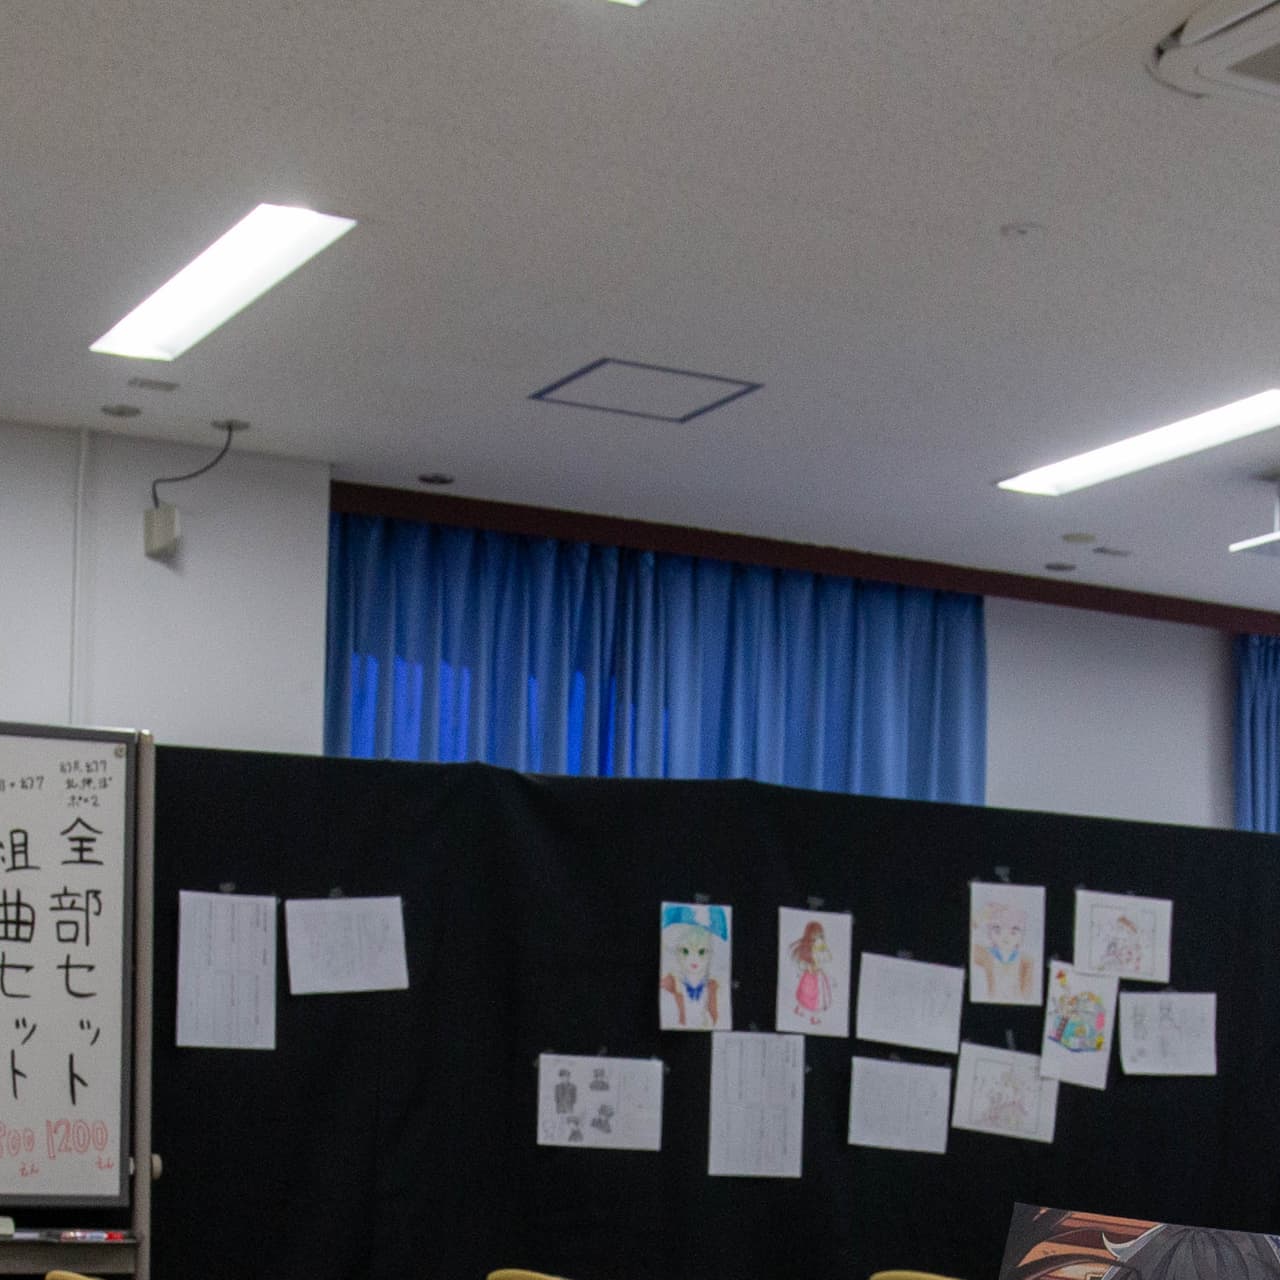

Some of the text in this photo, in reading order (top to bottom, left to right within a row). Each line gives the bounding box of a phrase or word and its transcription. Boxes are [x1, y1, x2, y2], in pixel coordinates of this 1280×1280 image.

[49, 817, 103, 1106] 全部セット
